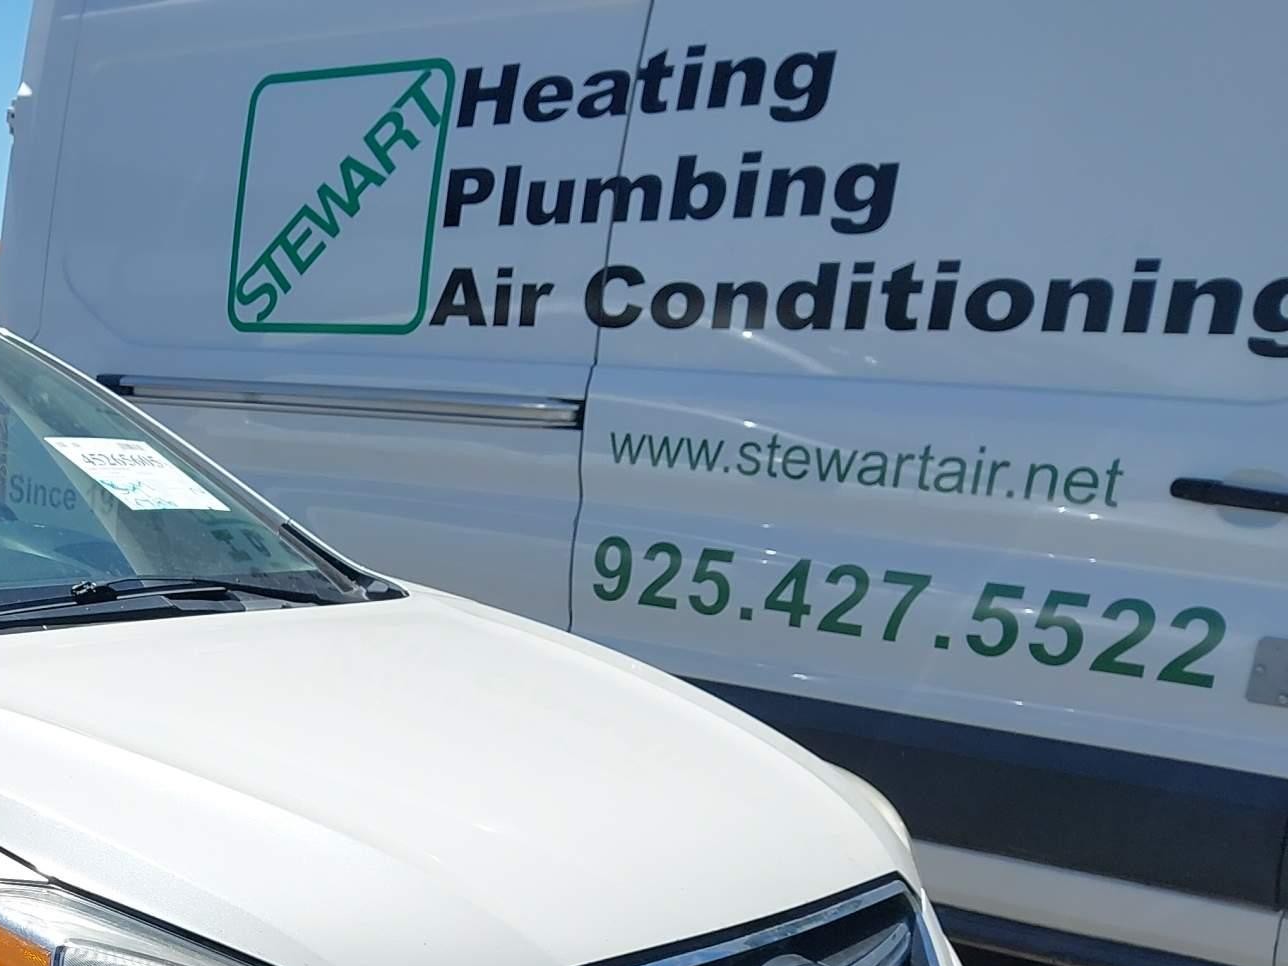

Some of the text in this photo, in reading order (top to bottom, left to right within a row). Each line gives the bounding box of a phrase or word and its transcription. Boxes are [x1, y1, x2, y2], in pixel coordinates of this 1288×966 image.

[456, 44, 837, 128] Heating
[236, 71, 441, 322] STEWART
[443, 151, 900, 234] Plumbing
[429, 267, 554, 327] Air
[9, 472, 76, 511] Since
[610, 432, 1123, 507] www.stewartair.net
[593, 535, 1226, 688] 925.427.5522
